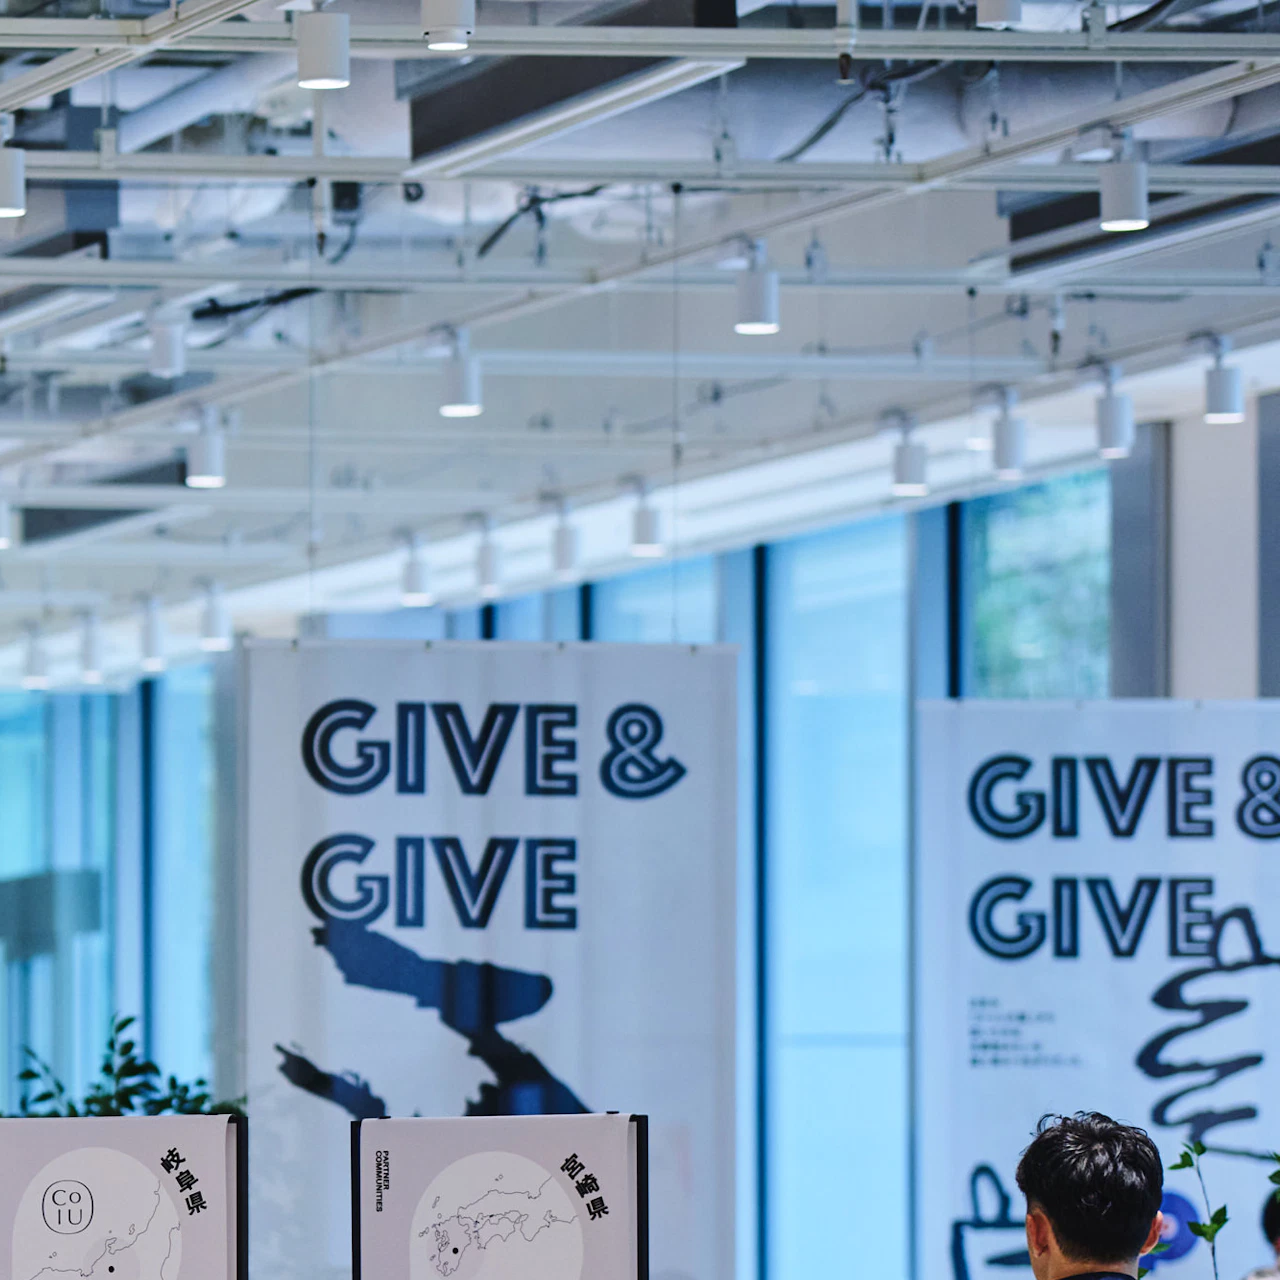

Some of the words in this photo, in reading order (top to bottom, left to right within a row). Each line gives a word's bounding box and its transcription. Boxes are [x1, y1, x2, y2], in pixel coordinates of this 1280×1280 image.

[301, 699, 578, 797] GIVE
[599, 702, 688, 799] &
[968, 753, 1213, 840] GIVE
[300, 832, 578, 930] GIVE
[968, 874, 1214, 960] GIVE
[159, 1146, 208, 1216] 岐阜県
[375, 1150, 383, 1212] COMMUNITIES
[560, 1153, 609, 1222] 宮崎県
